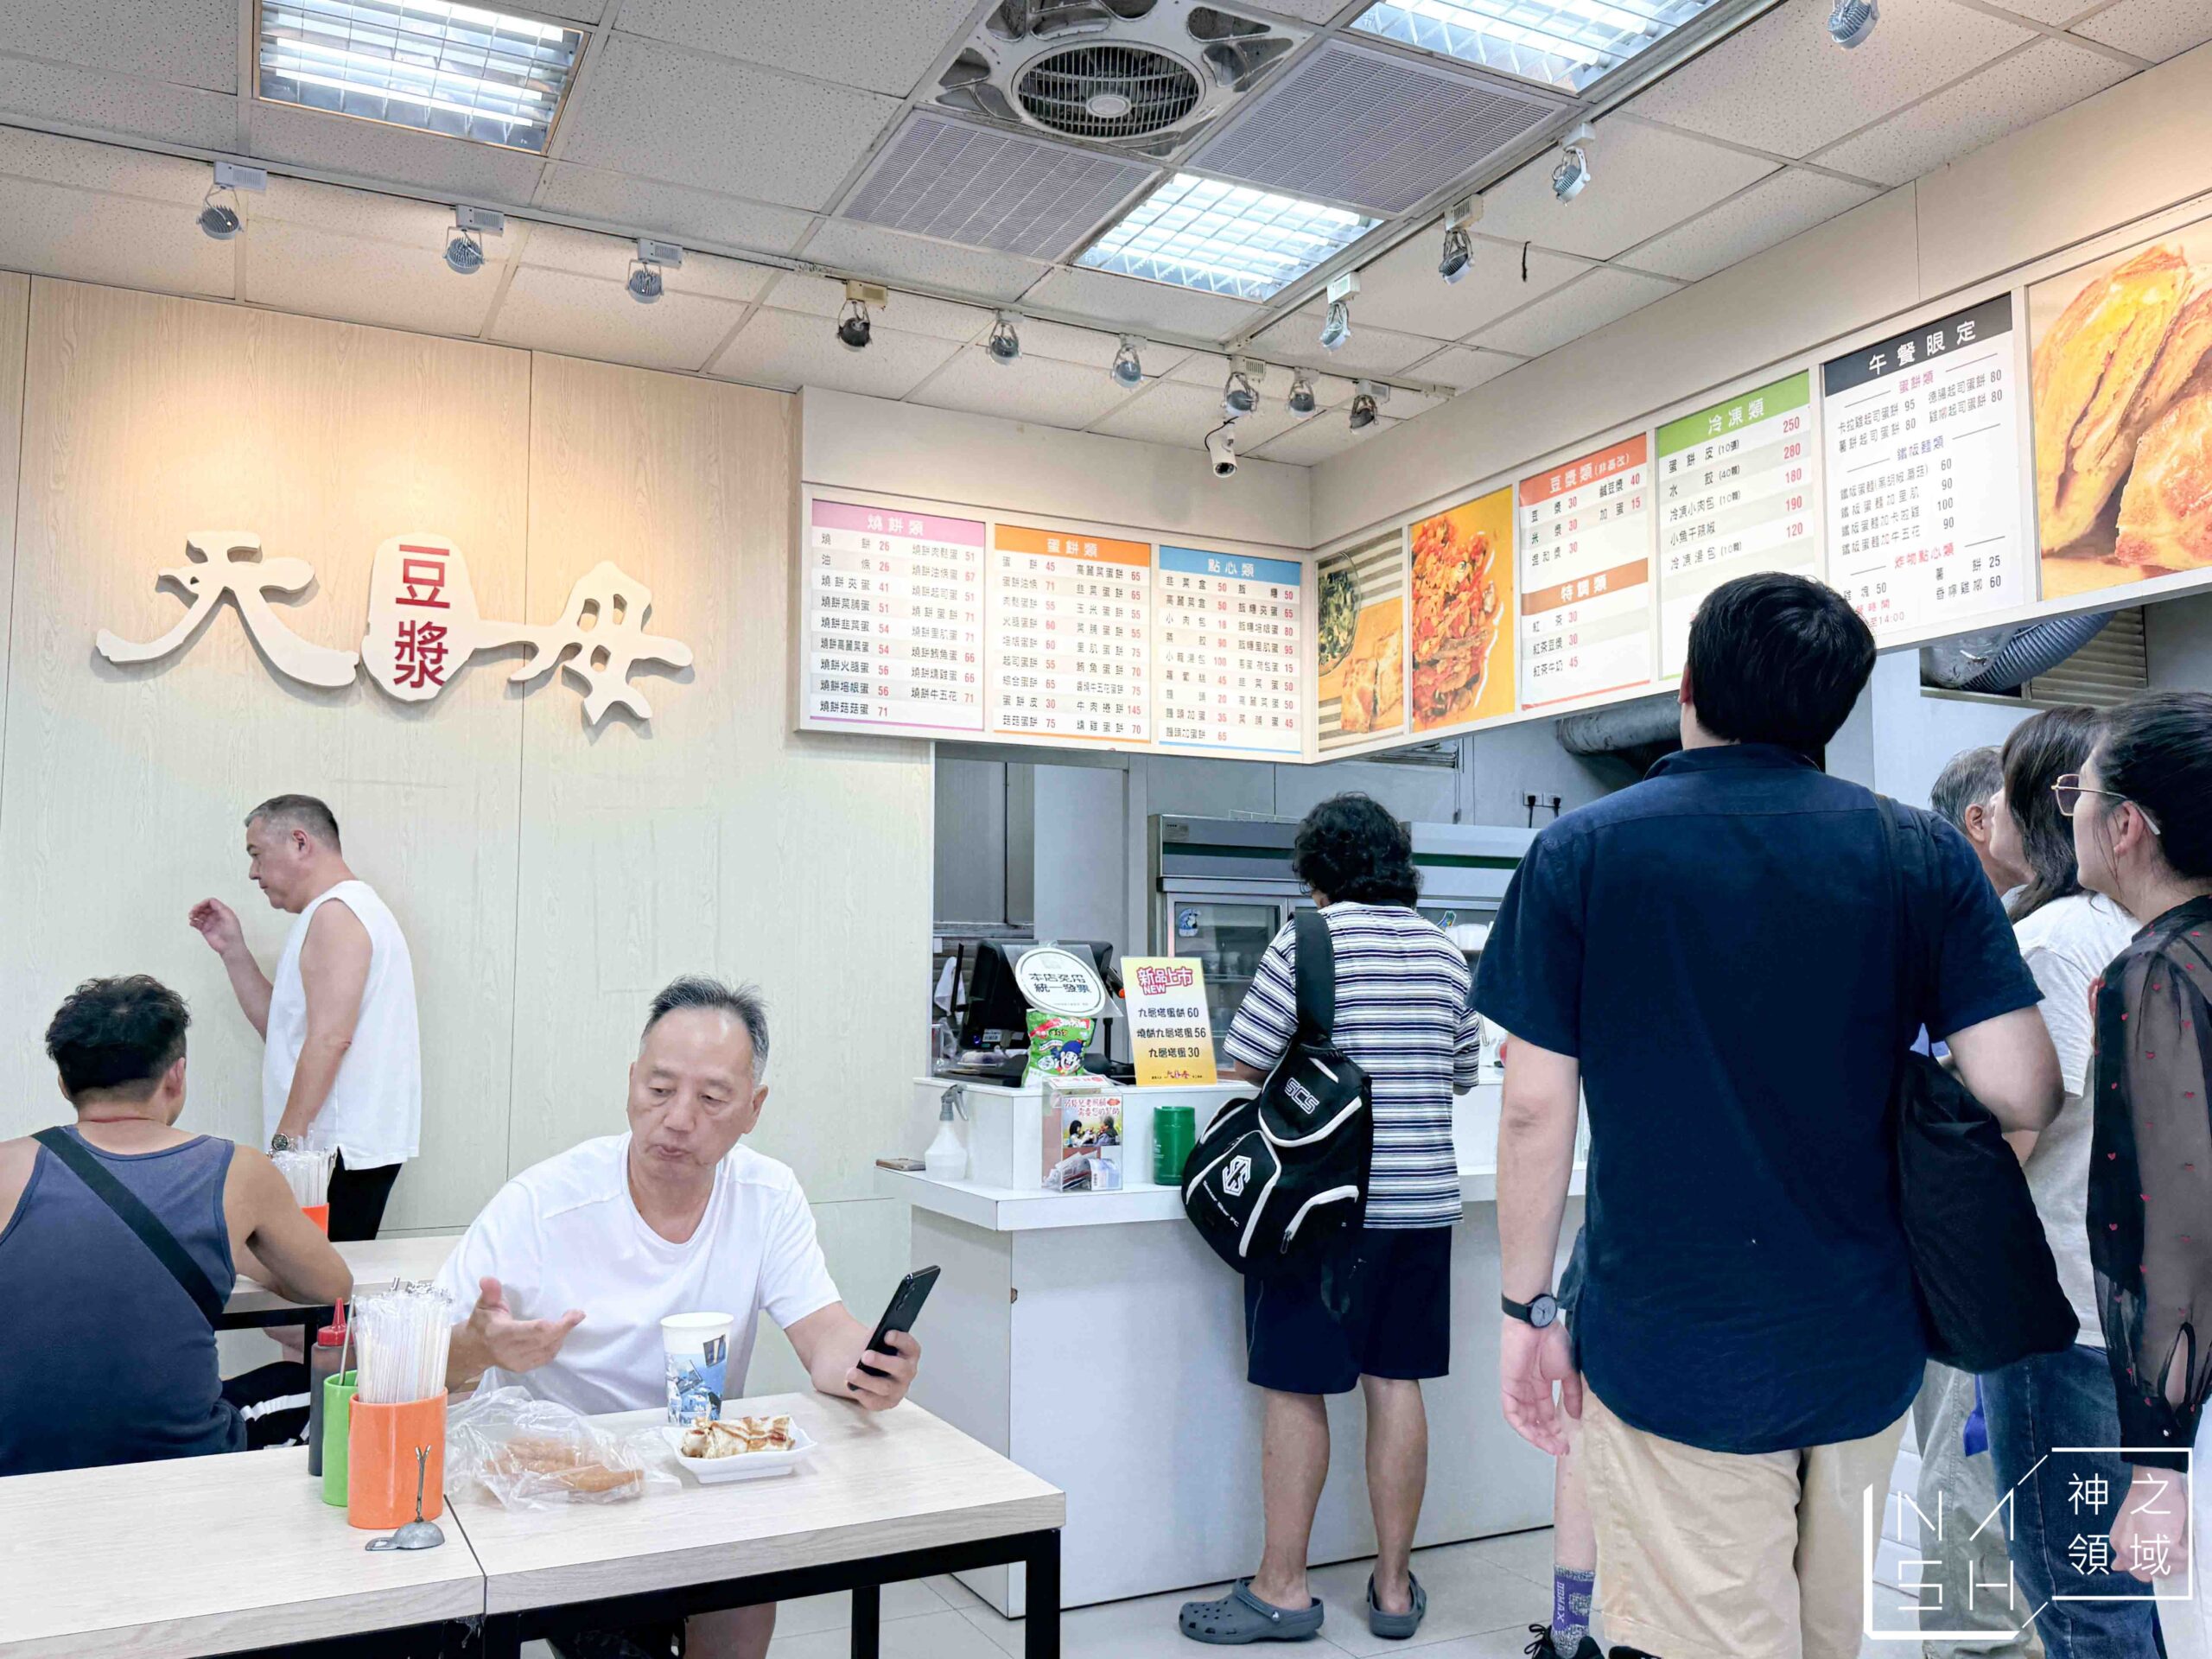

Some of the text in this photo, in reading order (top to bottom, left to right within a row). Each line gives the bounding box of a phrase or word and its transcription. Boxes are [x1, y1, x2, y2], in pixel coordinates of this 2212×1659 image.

[1869, 321, 1976, 375] 午餐限定
[1899, 369, 1935, 395] 蛋餅類
[1904, 397, 1916, 413] 95
[1990, 367, 2002, 385] 80
[1708, 397, 1764, 435] 冷凍類
[1905, 416, 1916, 432] 80
[1991, 388, 2003, 404] 80
[1783, 416, 1800, 435] 250
[1669, 472, 1713, 497] 水餃
[1783, 442, 1801, 461] 280
[1941, 457, 1952, 472] 60
[1549, 462, 1592, 494] 豆漿類
[1785, 467, 1802, 485] 180
[1942, 476, 1953, 492] 90
[1568, 495, 1577, 510] 30
[1630, 472, 1641, 487] 40
[1786, 495, 1802, 512] 190
[1938, 498, 1953, 510] 100
[1568, 518, 1578, 532] 30
[1631, 496, 1641, 511] 15
[1943, 516, 1955, 531] 90
[868, 513, 924, 537] 燒餅類
[1786, 521, 1803, 539] 120
[822, 533, 870, 548] 燒餅
[879, 540, 890, 552] 26
[965, 550, 976, 563] 51
[1046, 537, 1098, 559] 蛋餅類
[1569, 541, 1578, 555] 30
[1895, 541, 1955, 570] 炸物點心類
[822, 554, 869, 569] 油條
[879, 561, 890, 573] 26
[965, 571, 976, 583] 67
[1046, 561, 1056, 572] 45
[1131, 570, 1141, 582] 65
[1208, 558, 1255, 578] 點心類
[1876, 582, 1887, 595] 50
[1989, 556, 1999, 568] 25
[822, 575, 869, 589] 燒餅夾蛋
[880, 583, 888, 592] 41
[965, 591, 976, 601] 51
[1046, 581, 1141, 601] 71 65
[1989, 574, 2001, 589] 60
[1218, 582, 1294, 601] 50 50
[395, 543, 452, 690] 豆漿
[880, 603, 890, 614] 51
[912, 607, 957, 620] 燒餅蛋餅
[965, 613, 974, 621] 71
[1046, 600, 1056, 612] 55
[1131, 609, 1141, 620] 55
[1217, 601, 1227, 612] 50
[1285, 608, 1294, 619] 65
[1568, 610, 1578, 624] 30
[821, 617, 870, 633] 燒餅韭菜蛋
[879, 622, 889, 635] 54
[965, 632, 974, 642] 71
[1046, 620, 1056, 631] 60
[1131, 628, 1141, 639] 55
[1217, 619, 1227, 630] 18
[1285, 626, 1294, 638] 80
[1046, 639, 1141, 658] 60 75
[1217, 638, 1294, 656] 90 95
[1569, 632, 1579, 646] 30
[821, 637, 870, 653] 燒餅高麗菜蛋
[878, 643, 889, 655] 54
[964, 652, 975, 664] 66
[820, 658, 975, 683] 燒餅火腿蛋 56 66
[1046, 658, 1056, 670] 55
[1131, 666, 1141, 677] 70
[1214, 656, 1227, 667] 100
[1284, 664, 1293, 674] 15
[1569, 655, 1579, 669] 45
[820, 679, 869, 696] 燒餅培根蛋
[878, 684, 889, 696] 56
[964, 693, 973, 702] 71
[1045, 678, 1141, 696] 65 75
[1217, 675, 1294, 692] 45 50
[820, 700, 887, 716] 燒餅菇菇蛋 71
[1045, 698, 1056, 709] 30
[1127, 704, 1141, 716] 145
[1217, 694, 1294, 710] 20 50
[1046, 719, 1141, 735] 75 70
[1217, 712, 1293, 728] 35 45
[1217, 731, 1227, 741] 65
[1137, 966, 1193, 987] 新品上市
[1033, 983, 1092, 994] 統一發票
[1142, 984, 1166, 995] NEW
[1138, 1007, 1199, 1018] 九層塔蛋餅 60
[1136, 1027, 1206, 1039] 燒餅九層塔蛋 56
[1148, 1046, 1200, 1058] 九層塔蛋 30
[1284, 1077, 1320, 1115] SCS
